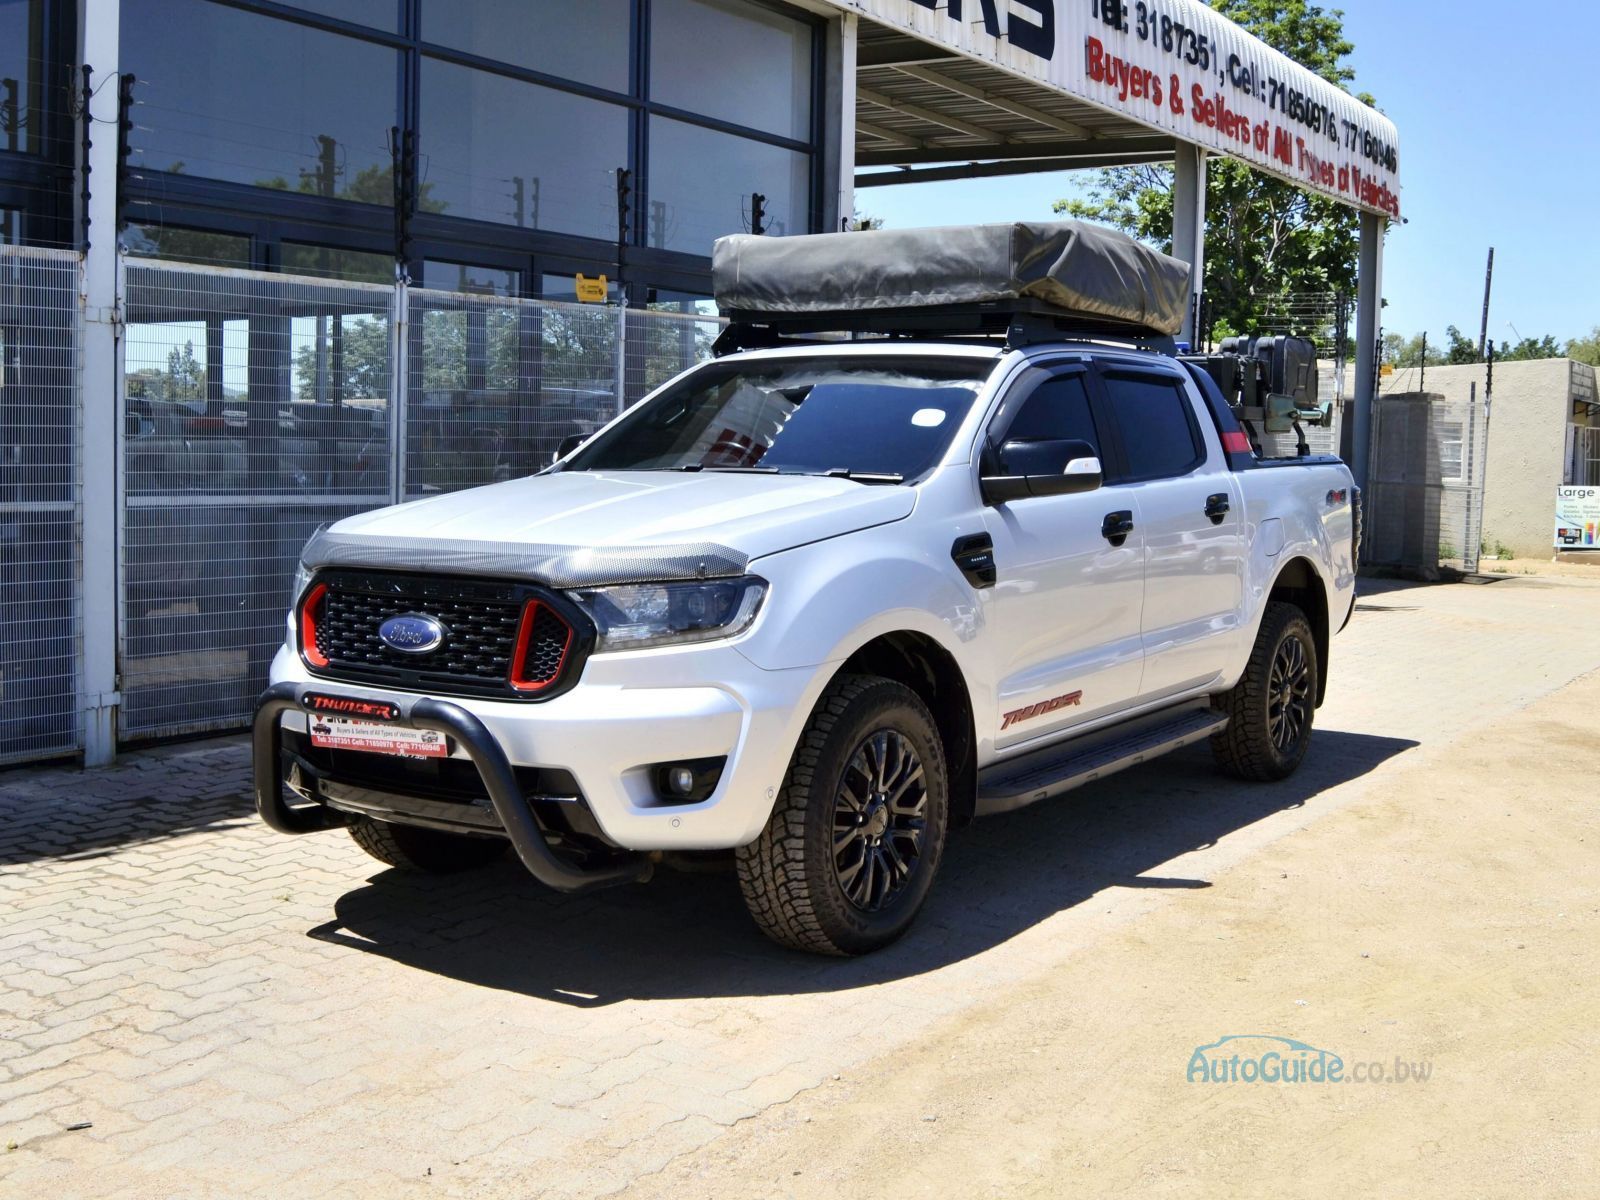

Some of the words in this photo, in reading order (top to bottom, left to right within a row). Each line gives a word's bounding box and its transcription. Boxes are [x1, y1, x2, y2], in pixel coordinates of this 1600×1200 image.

[1087, 36, 1163, 106] Buyers
[1170, 74, 1184, 115] &
[1191, 83, 1250, 144] Sellers
[1254, 120, 1269, 155] of
[1274, 126, 1293, 167] All
[1296, 136, 1335, 187] Types
[1338, 162, 1350, 193] of
[1352, 165, 1399, 217] Vehicles
[1557, 487, 1595, 499] Large
[390, 622, 424, 644] Ford
[313, 697, 391, 719] THUNDER
[1000, 689, 1083, 730] THUNDER
